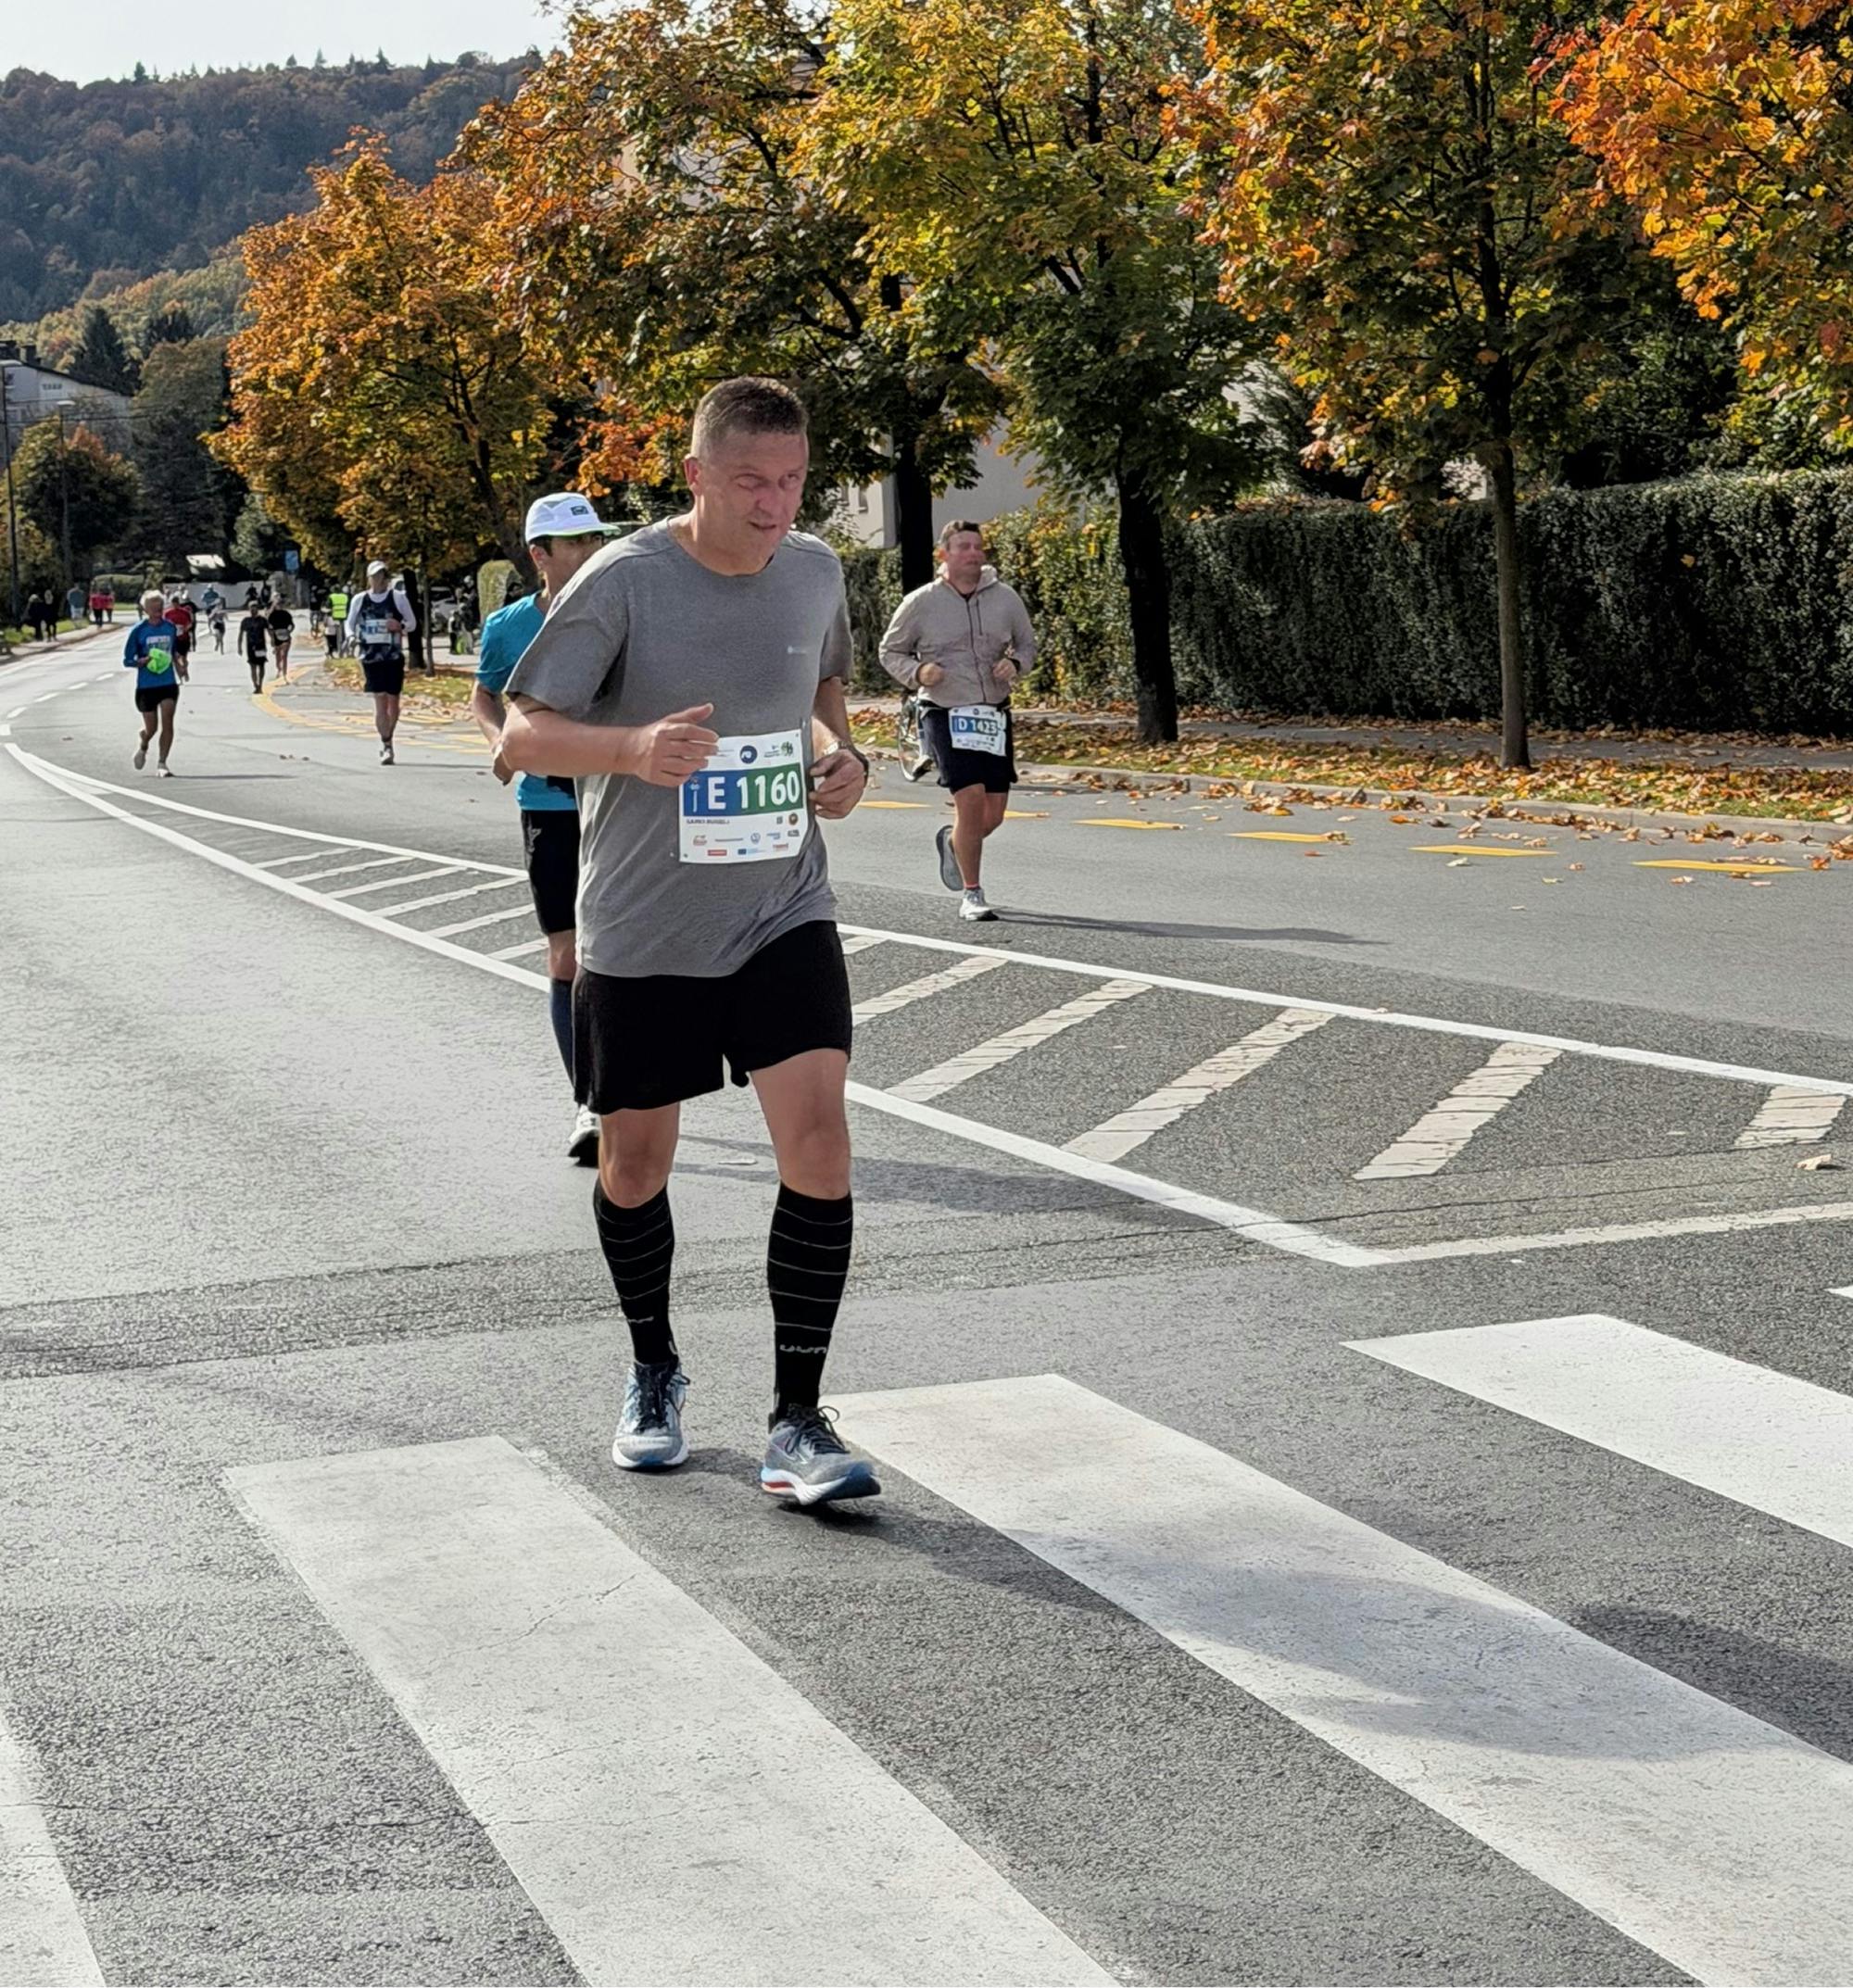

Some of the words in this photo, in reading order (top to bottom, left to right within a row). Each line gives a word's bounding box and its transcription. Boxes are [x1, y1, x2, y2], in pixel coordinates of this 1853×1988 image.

[958, 718, 968, 731] D
[708, 776, 726, 810] E
[737, 771, 800, 811] 1160
